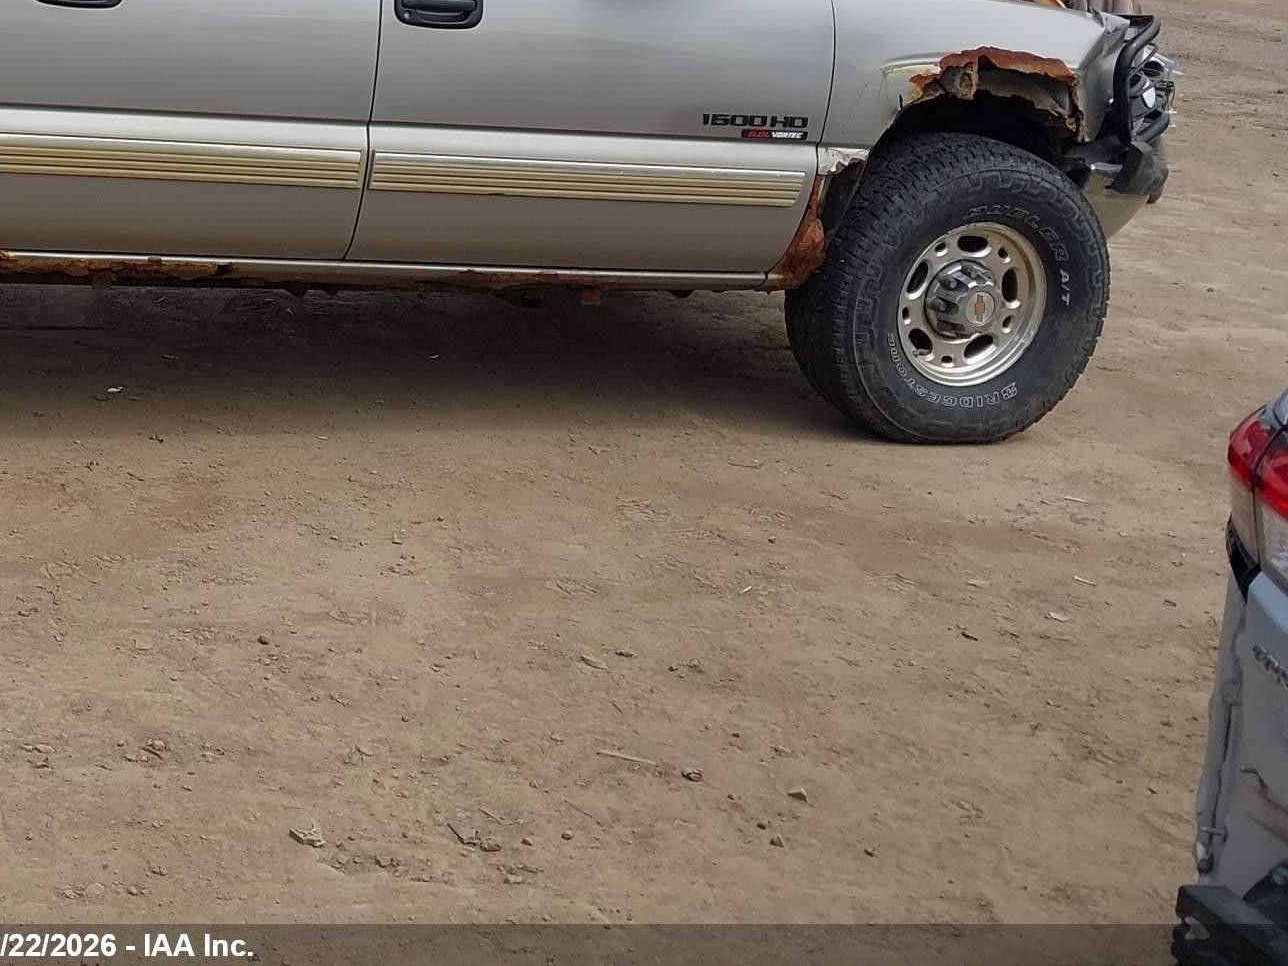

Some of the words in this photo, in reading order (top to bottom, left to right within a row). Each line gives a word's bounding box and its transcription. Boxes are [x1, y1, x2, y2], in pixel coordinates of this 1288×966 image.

[770, 115, 809, 129] HD
[771, 131, 804, 139] VORTEC
[886, 332, 1019, 408] BRIDGESTONE
